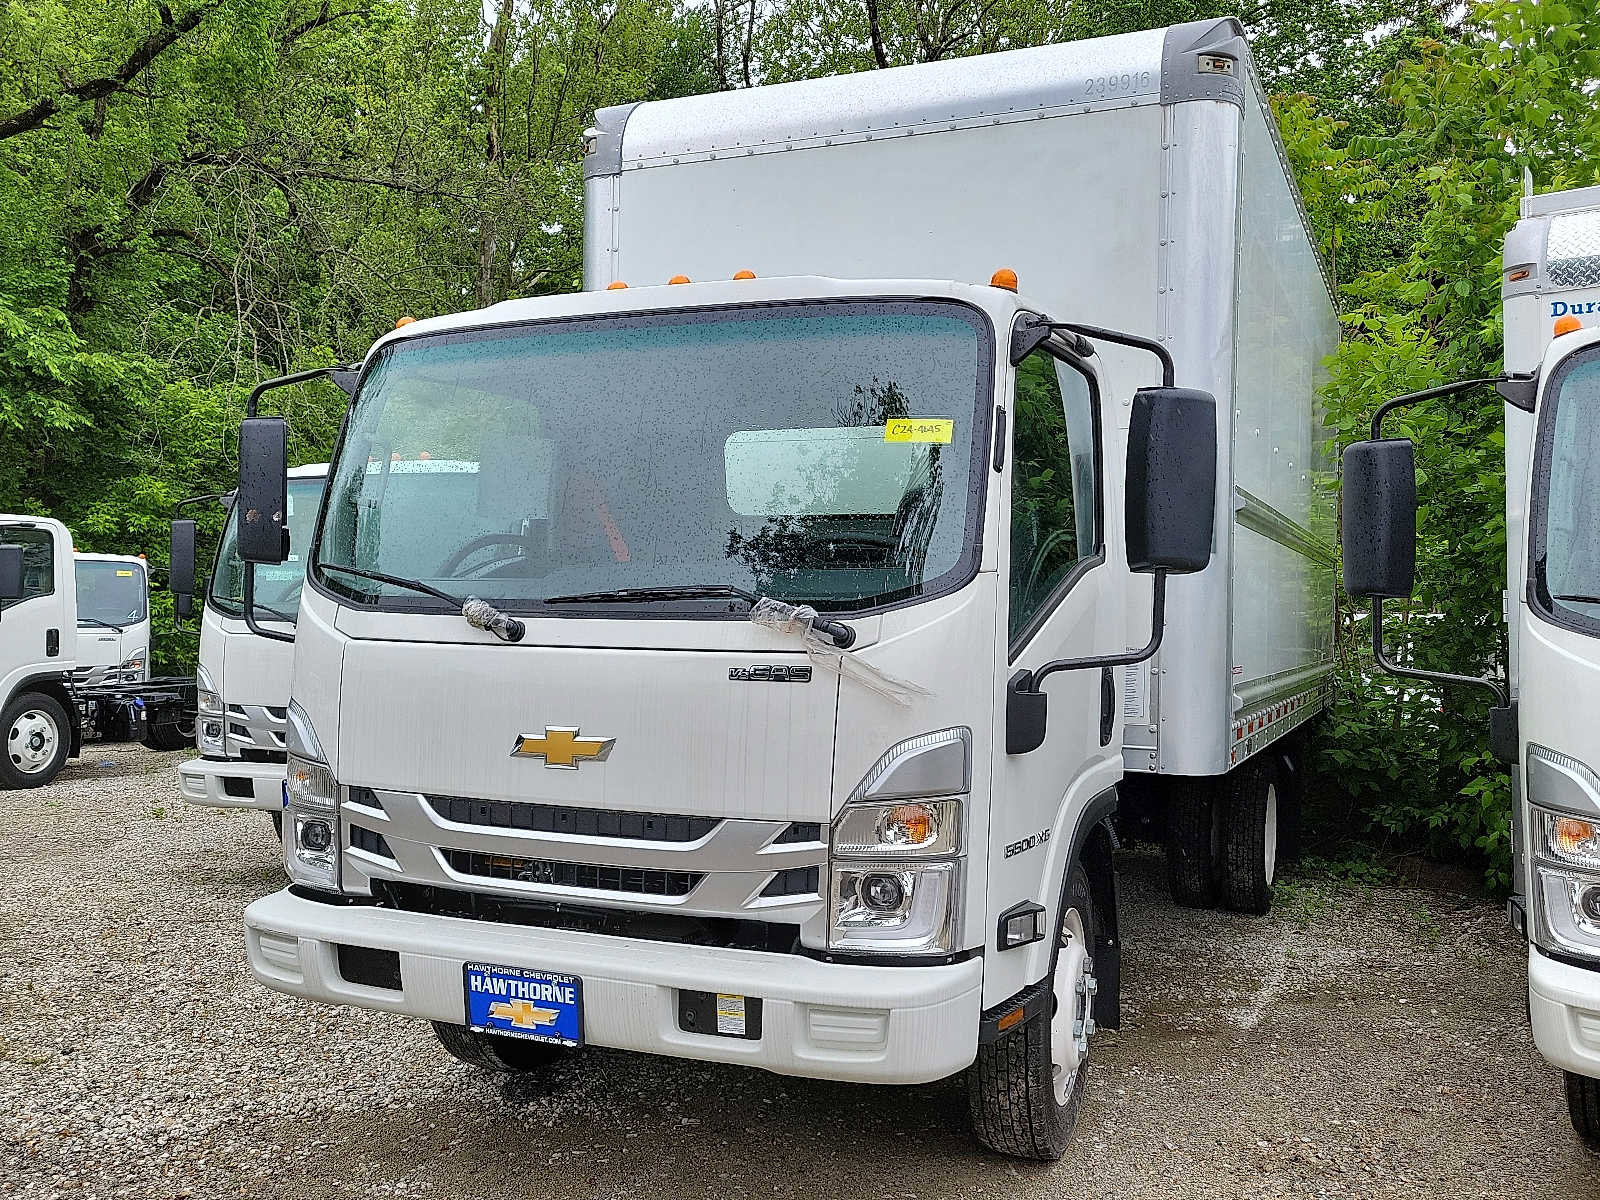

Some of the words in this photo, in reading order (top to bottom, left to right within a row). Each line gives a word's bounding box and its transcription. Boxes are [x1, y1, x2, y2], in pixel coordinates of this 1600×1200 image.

[467, 963, 521, 976] HAWTHORNE
[523, 971, 574, 983] CHEVROLET
[470, 975, 575, 1004] HAWTHORNE
